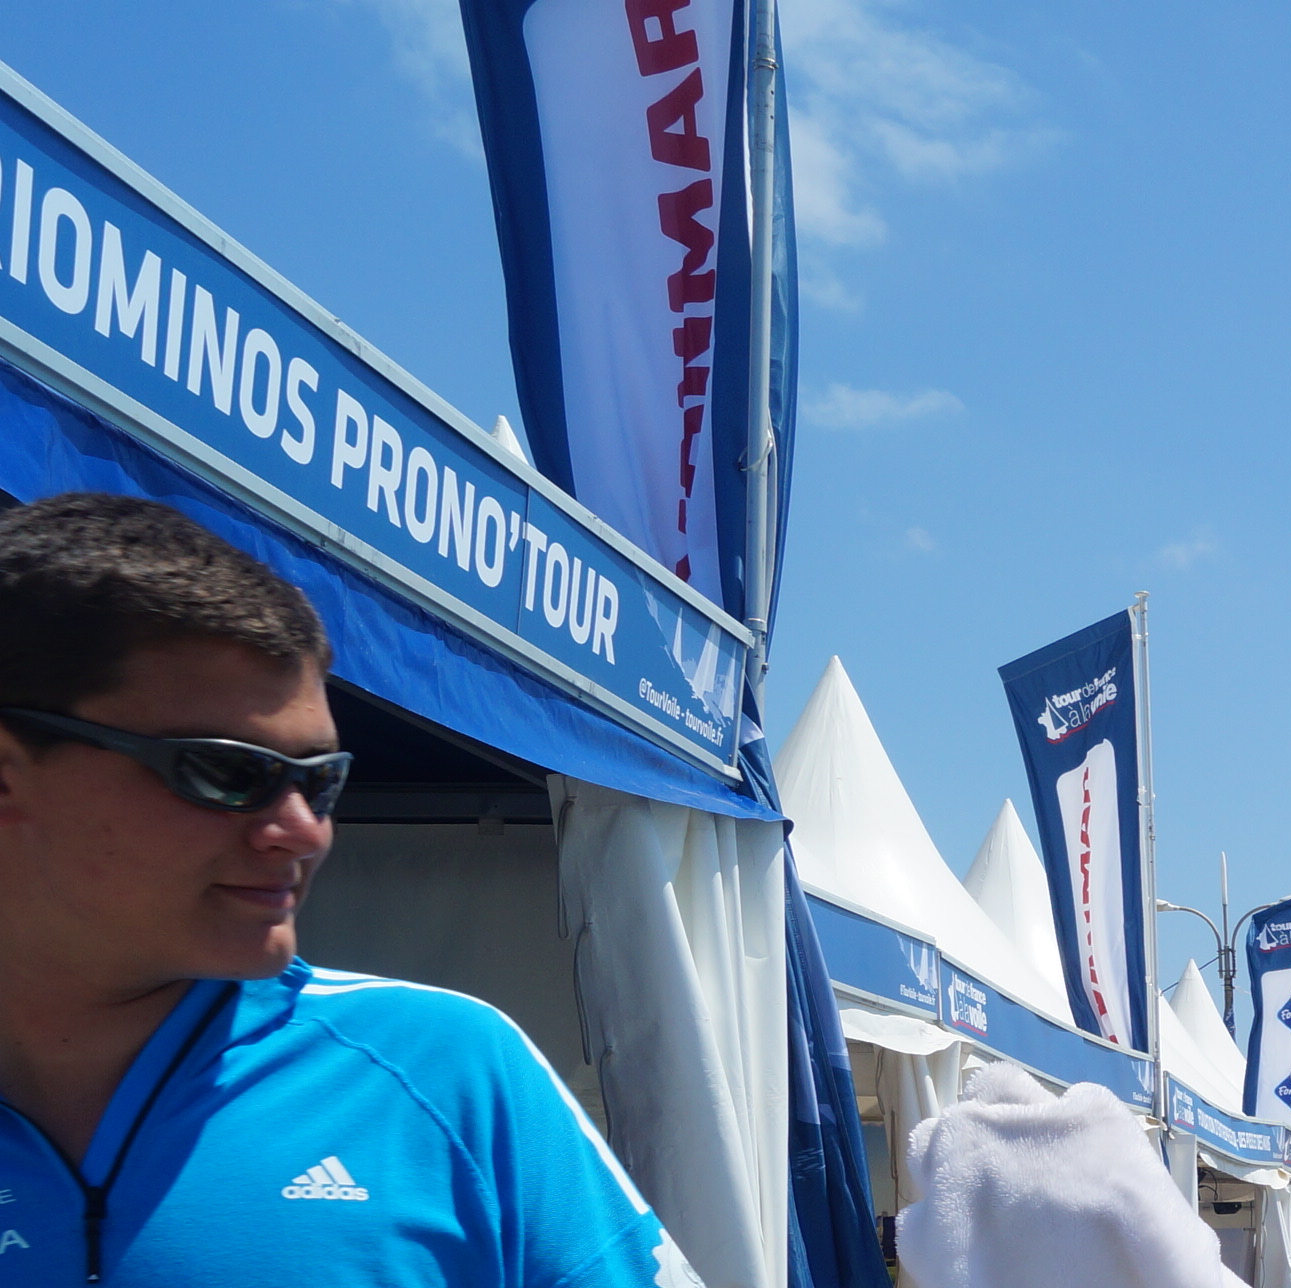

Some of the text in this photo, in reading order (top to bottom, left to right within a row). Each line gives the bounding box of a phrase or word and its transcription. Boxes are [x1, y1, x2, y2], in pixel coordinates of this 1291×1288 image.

[0, 155, 619, 665] IOMINOS PRONO'TOUR
[639, 678, 724, 747] @TourVoile tourvoile.fr
[1053, 689, 1081, 708] tour
[281, 1183, 369, 1201] adidas
